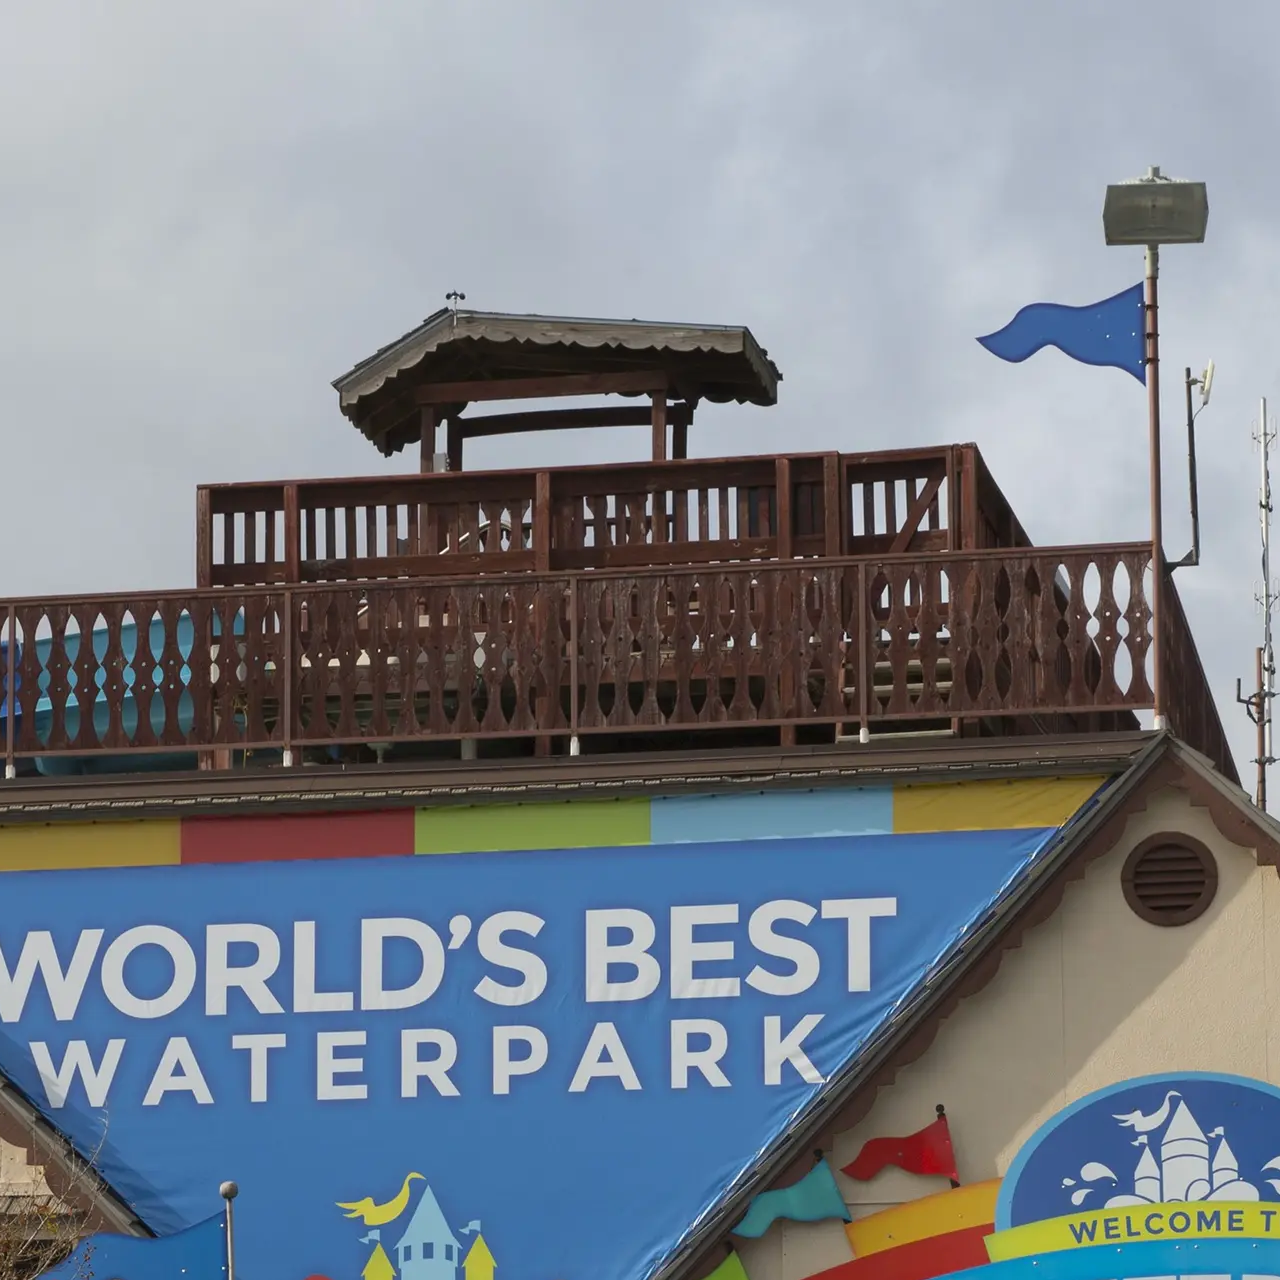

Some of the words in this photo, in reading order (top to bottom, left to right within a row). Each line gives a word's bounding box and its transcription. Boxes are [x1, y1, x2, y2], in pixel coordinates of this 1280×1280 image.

[586, 897, 897, 1003] BEST
[29, 1013, 827, 1108] WATERPARK
[1069, 1210, 1244, 1244] WELCOME
